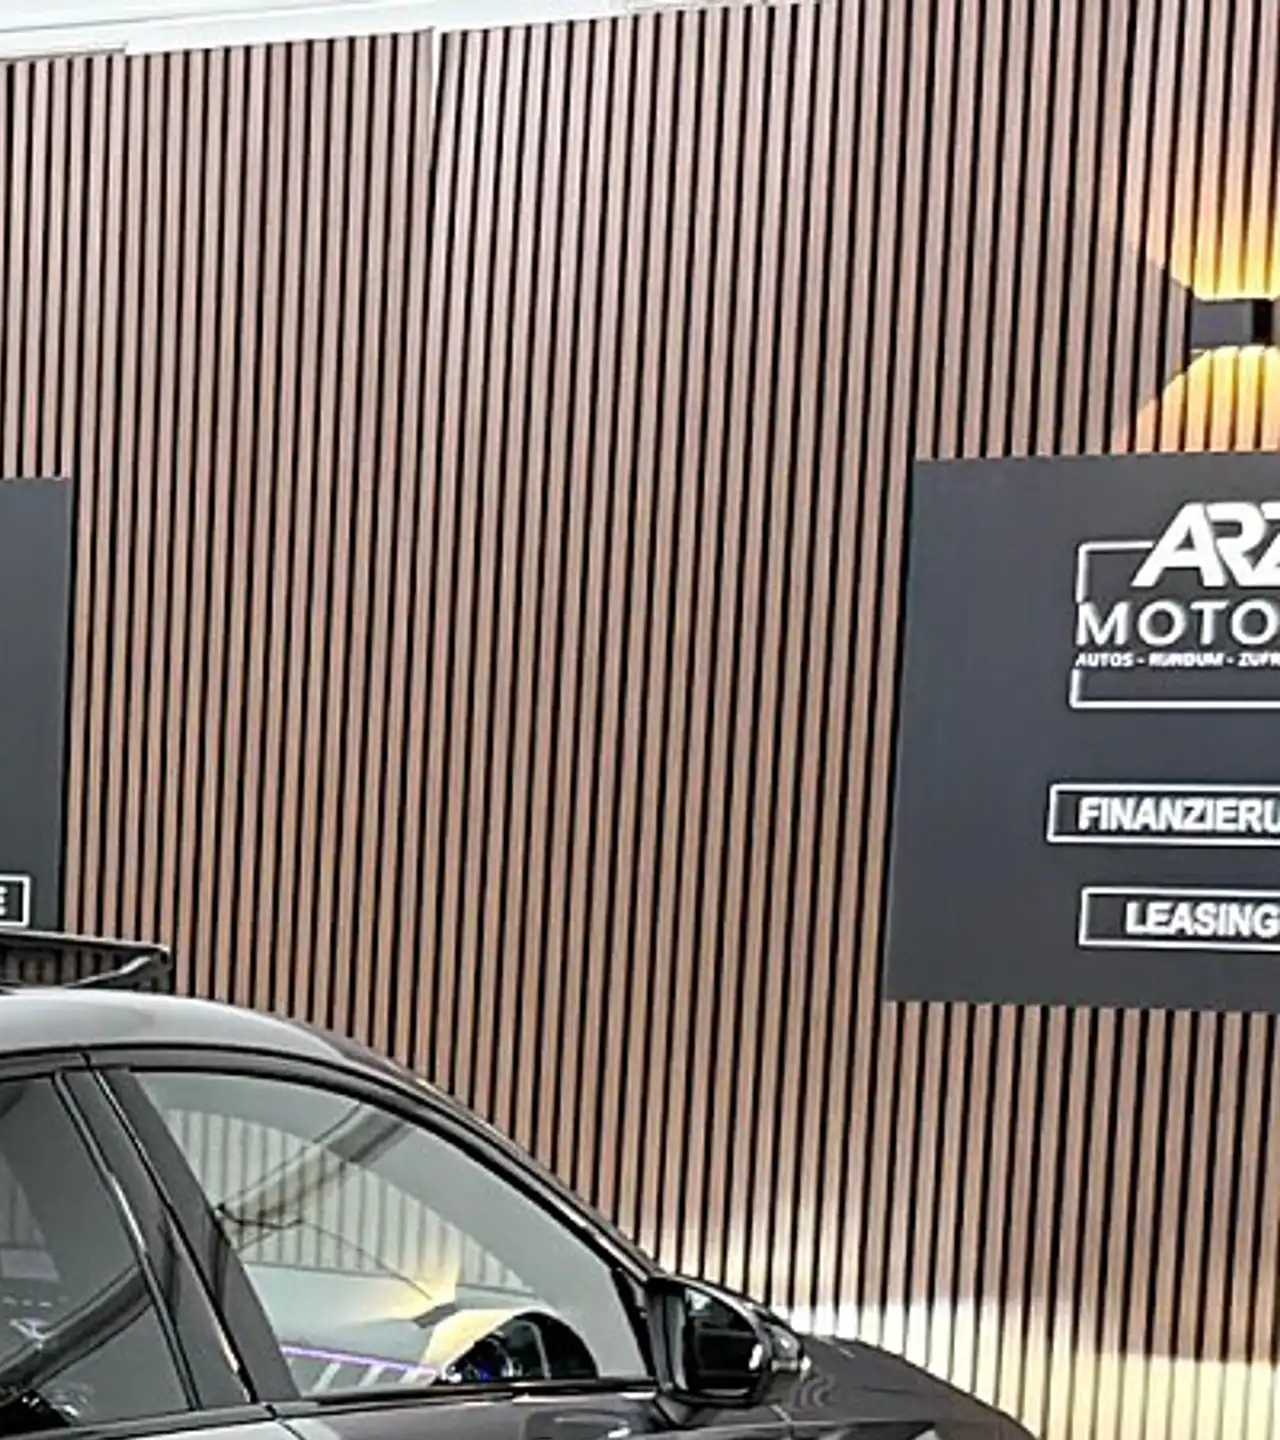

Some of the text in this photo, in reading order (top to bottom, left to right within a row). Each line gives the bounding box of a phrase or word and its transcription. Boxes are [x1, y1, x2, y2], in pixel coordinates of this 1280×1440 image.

[1074, 652, 1135, 667] AUTOS
[1148, 652, 1225, 667] RUNDUM
[1126, 901, 1280, 939] LEASING
